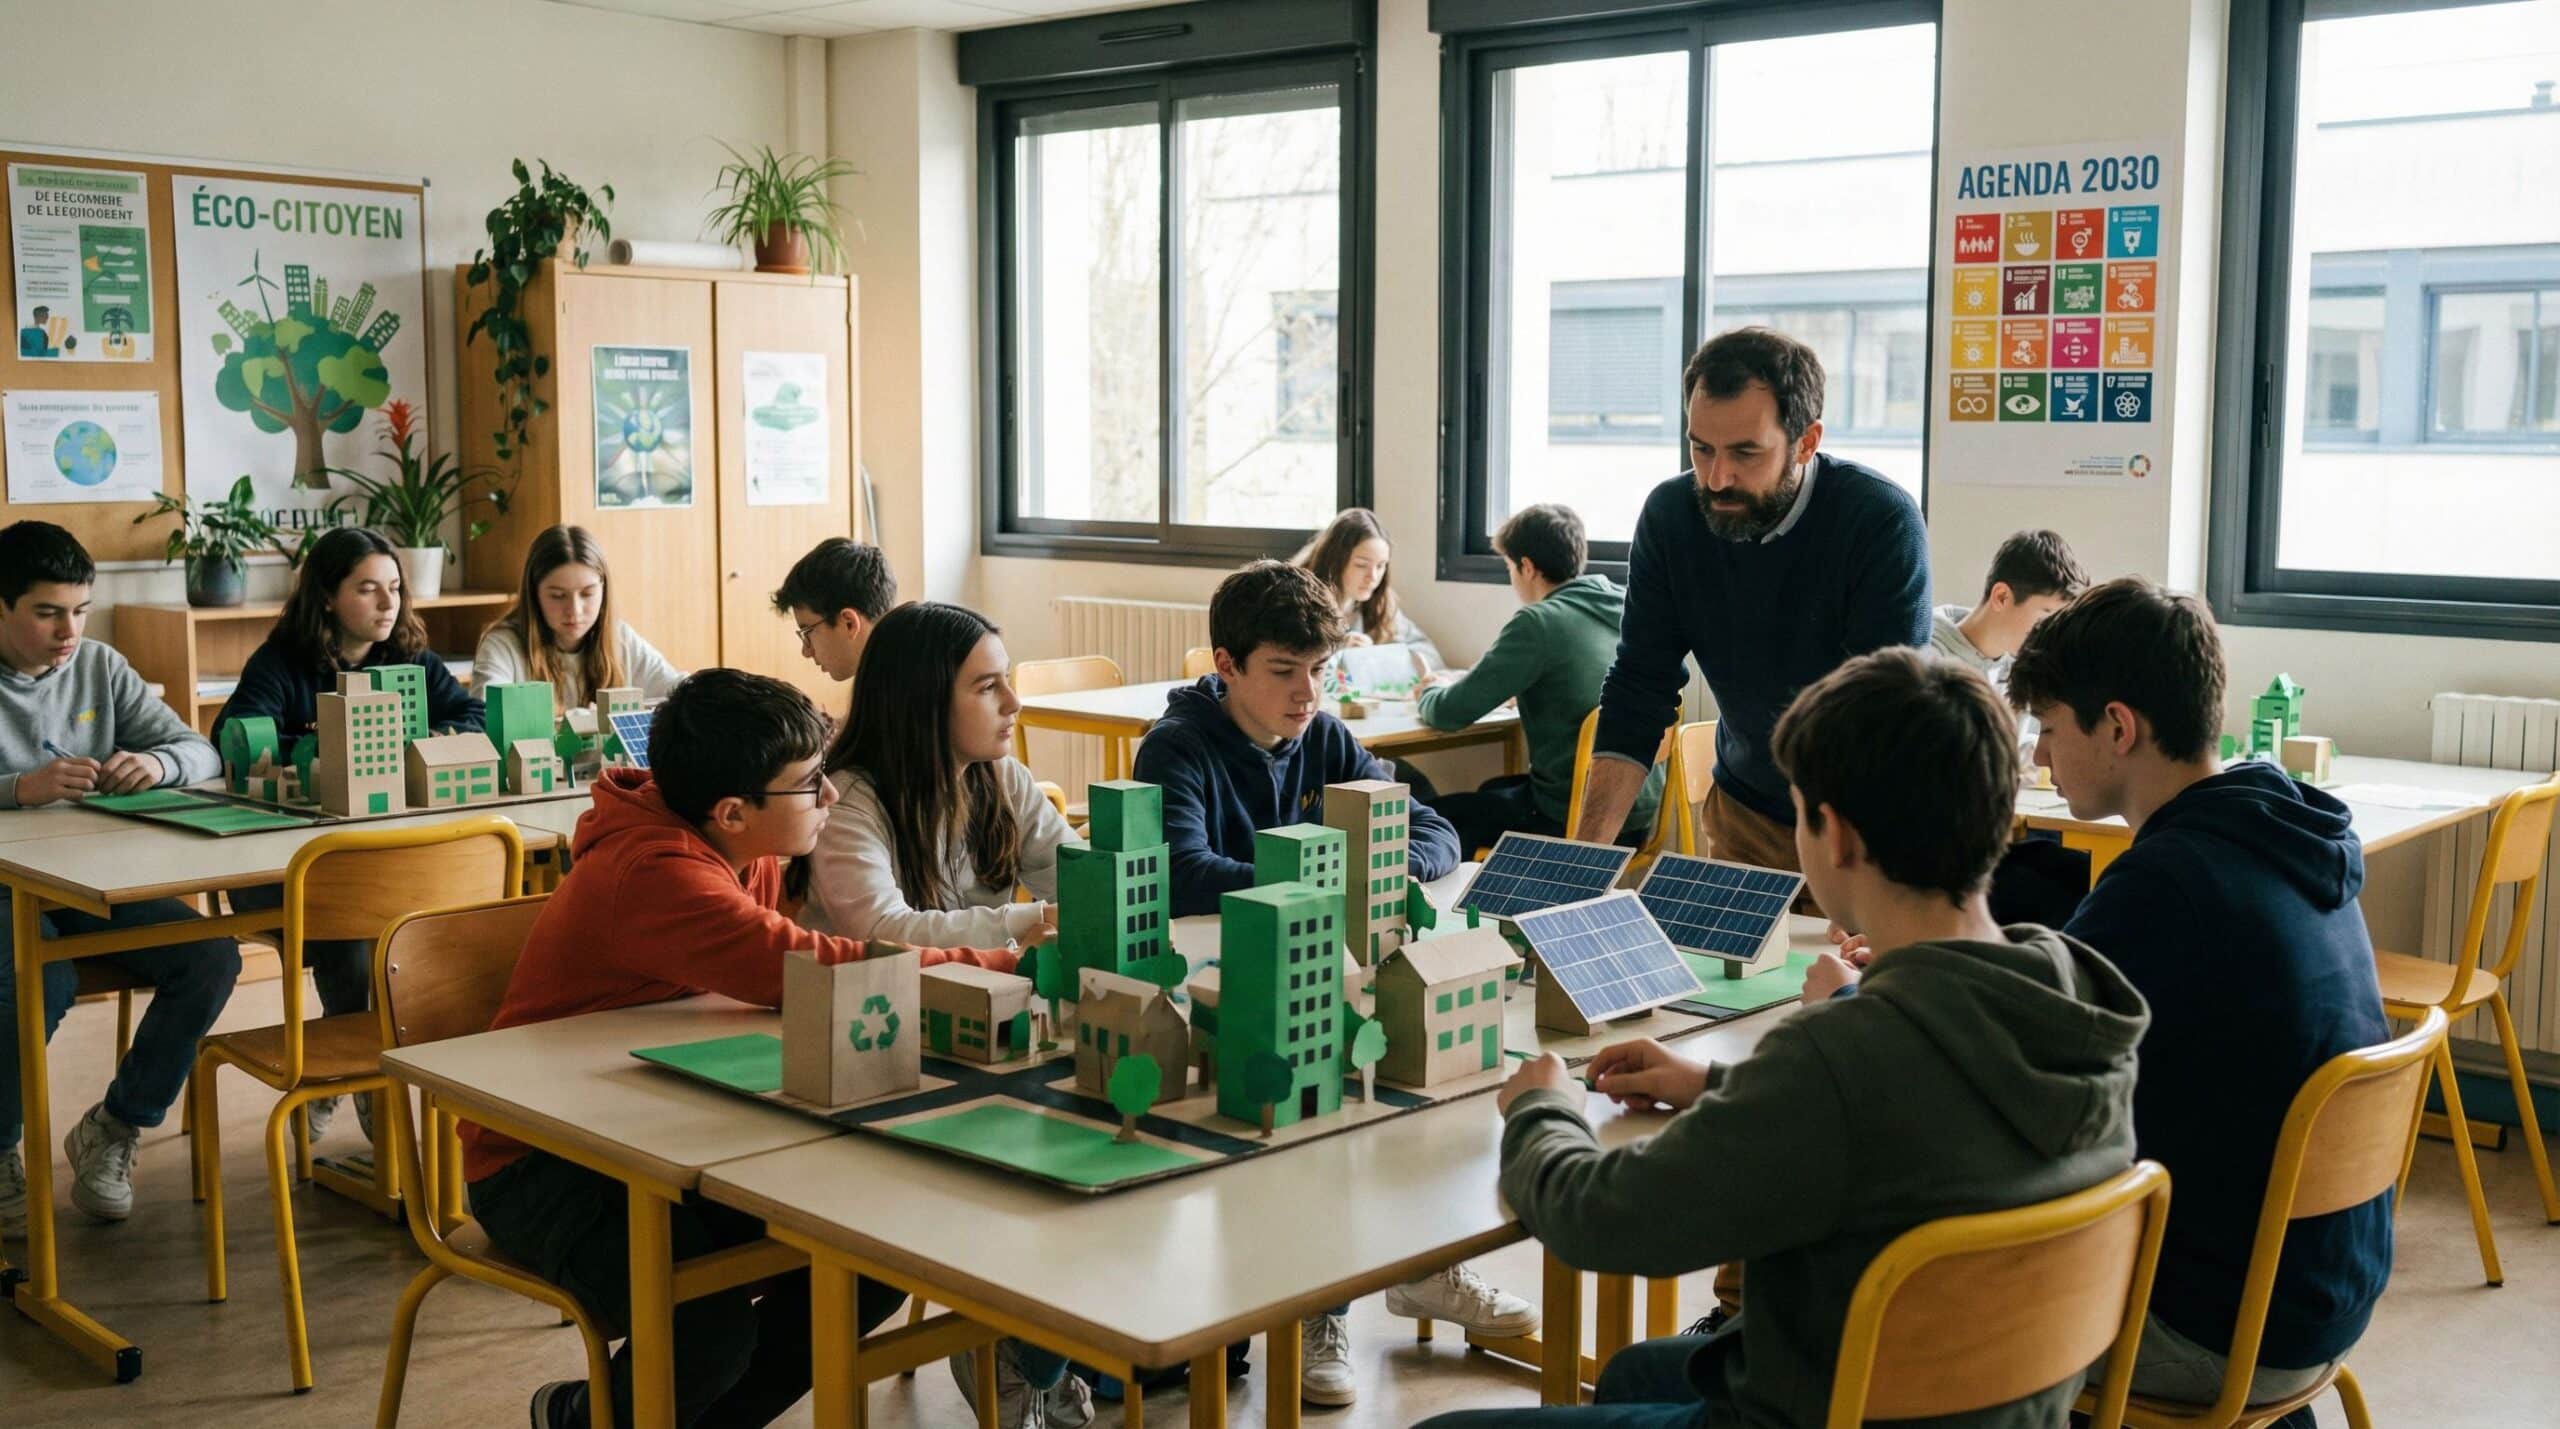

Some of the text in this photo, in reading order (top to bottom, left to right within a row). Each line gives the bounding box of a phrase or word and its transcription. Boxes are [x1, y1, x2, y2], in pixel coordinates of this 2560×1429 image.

[1958, 155, 2160, 199] AGENDA 2030
[192, 185, 403, 239] ÉCO-CITOYEN
